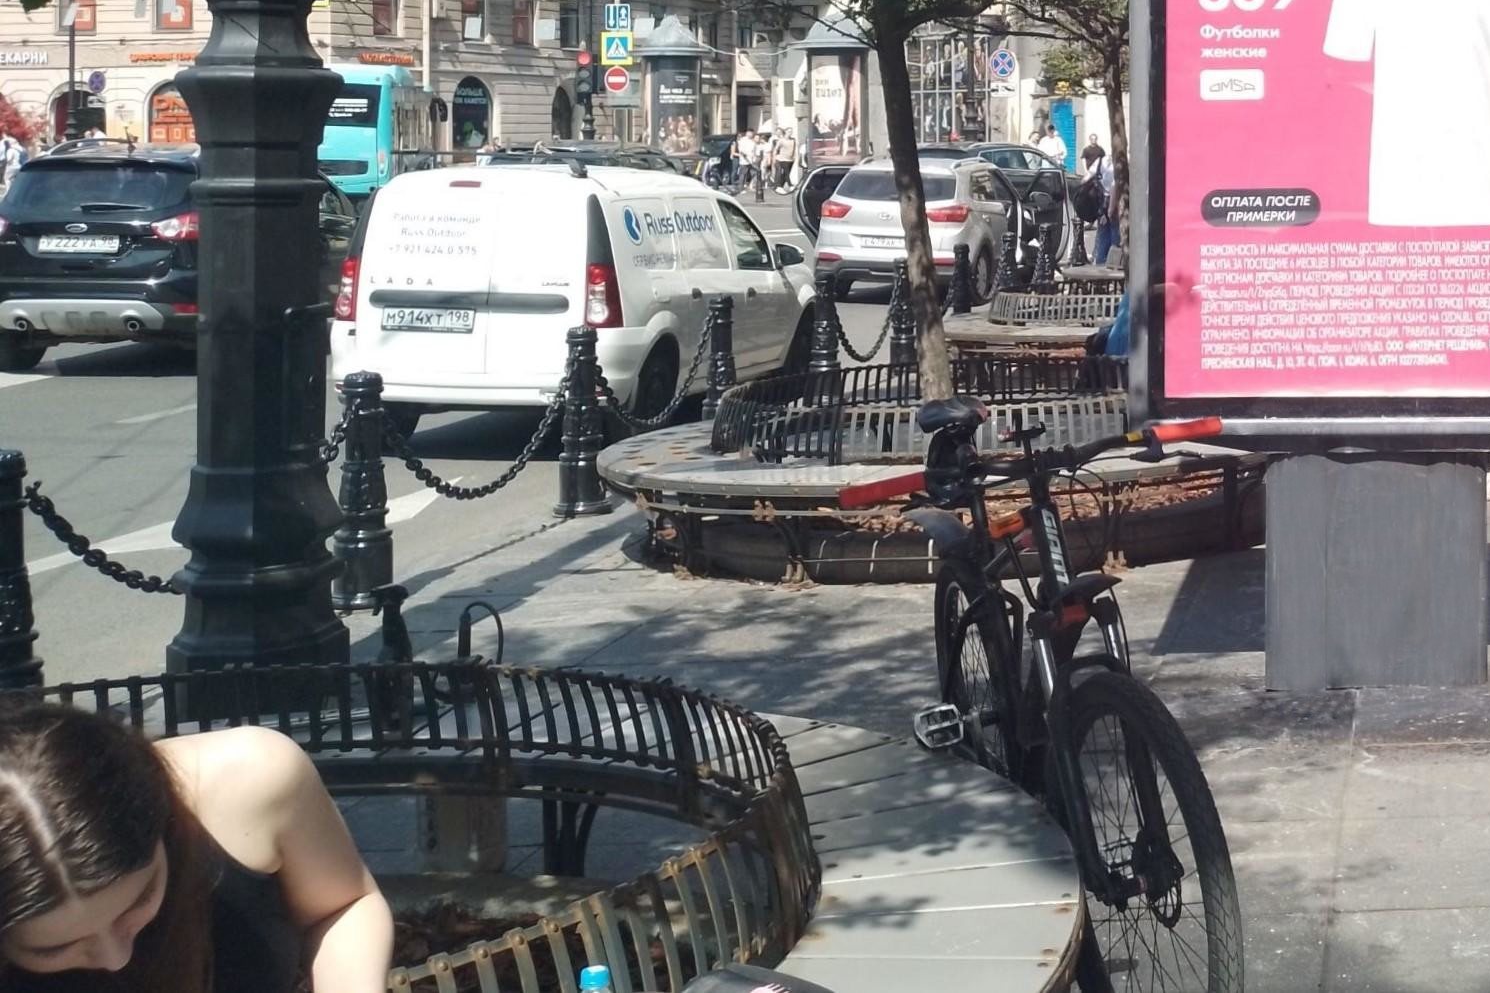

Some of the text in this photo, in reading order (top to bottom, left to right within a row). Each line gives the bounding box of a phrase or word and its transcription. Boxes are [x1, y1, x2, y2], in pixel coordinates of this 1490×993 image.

[1200, 24, 1281, 42] Футболки
[1201, 47, 1268, 59] женские
[1211, 195, 1311, 208] ОПЛАТА ПОСЛЕ
[644, 209, 714, 236] Russ Outdoor
[1226, 210, 1296, 222] ПРИМЕРКИ
[370, 276, 433, 286] LADA
[447, 310, 470, 323] 198
[1041, 509, 1070, 584] GIANT
